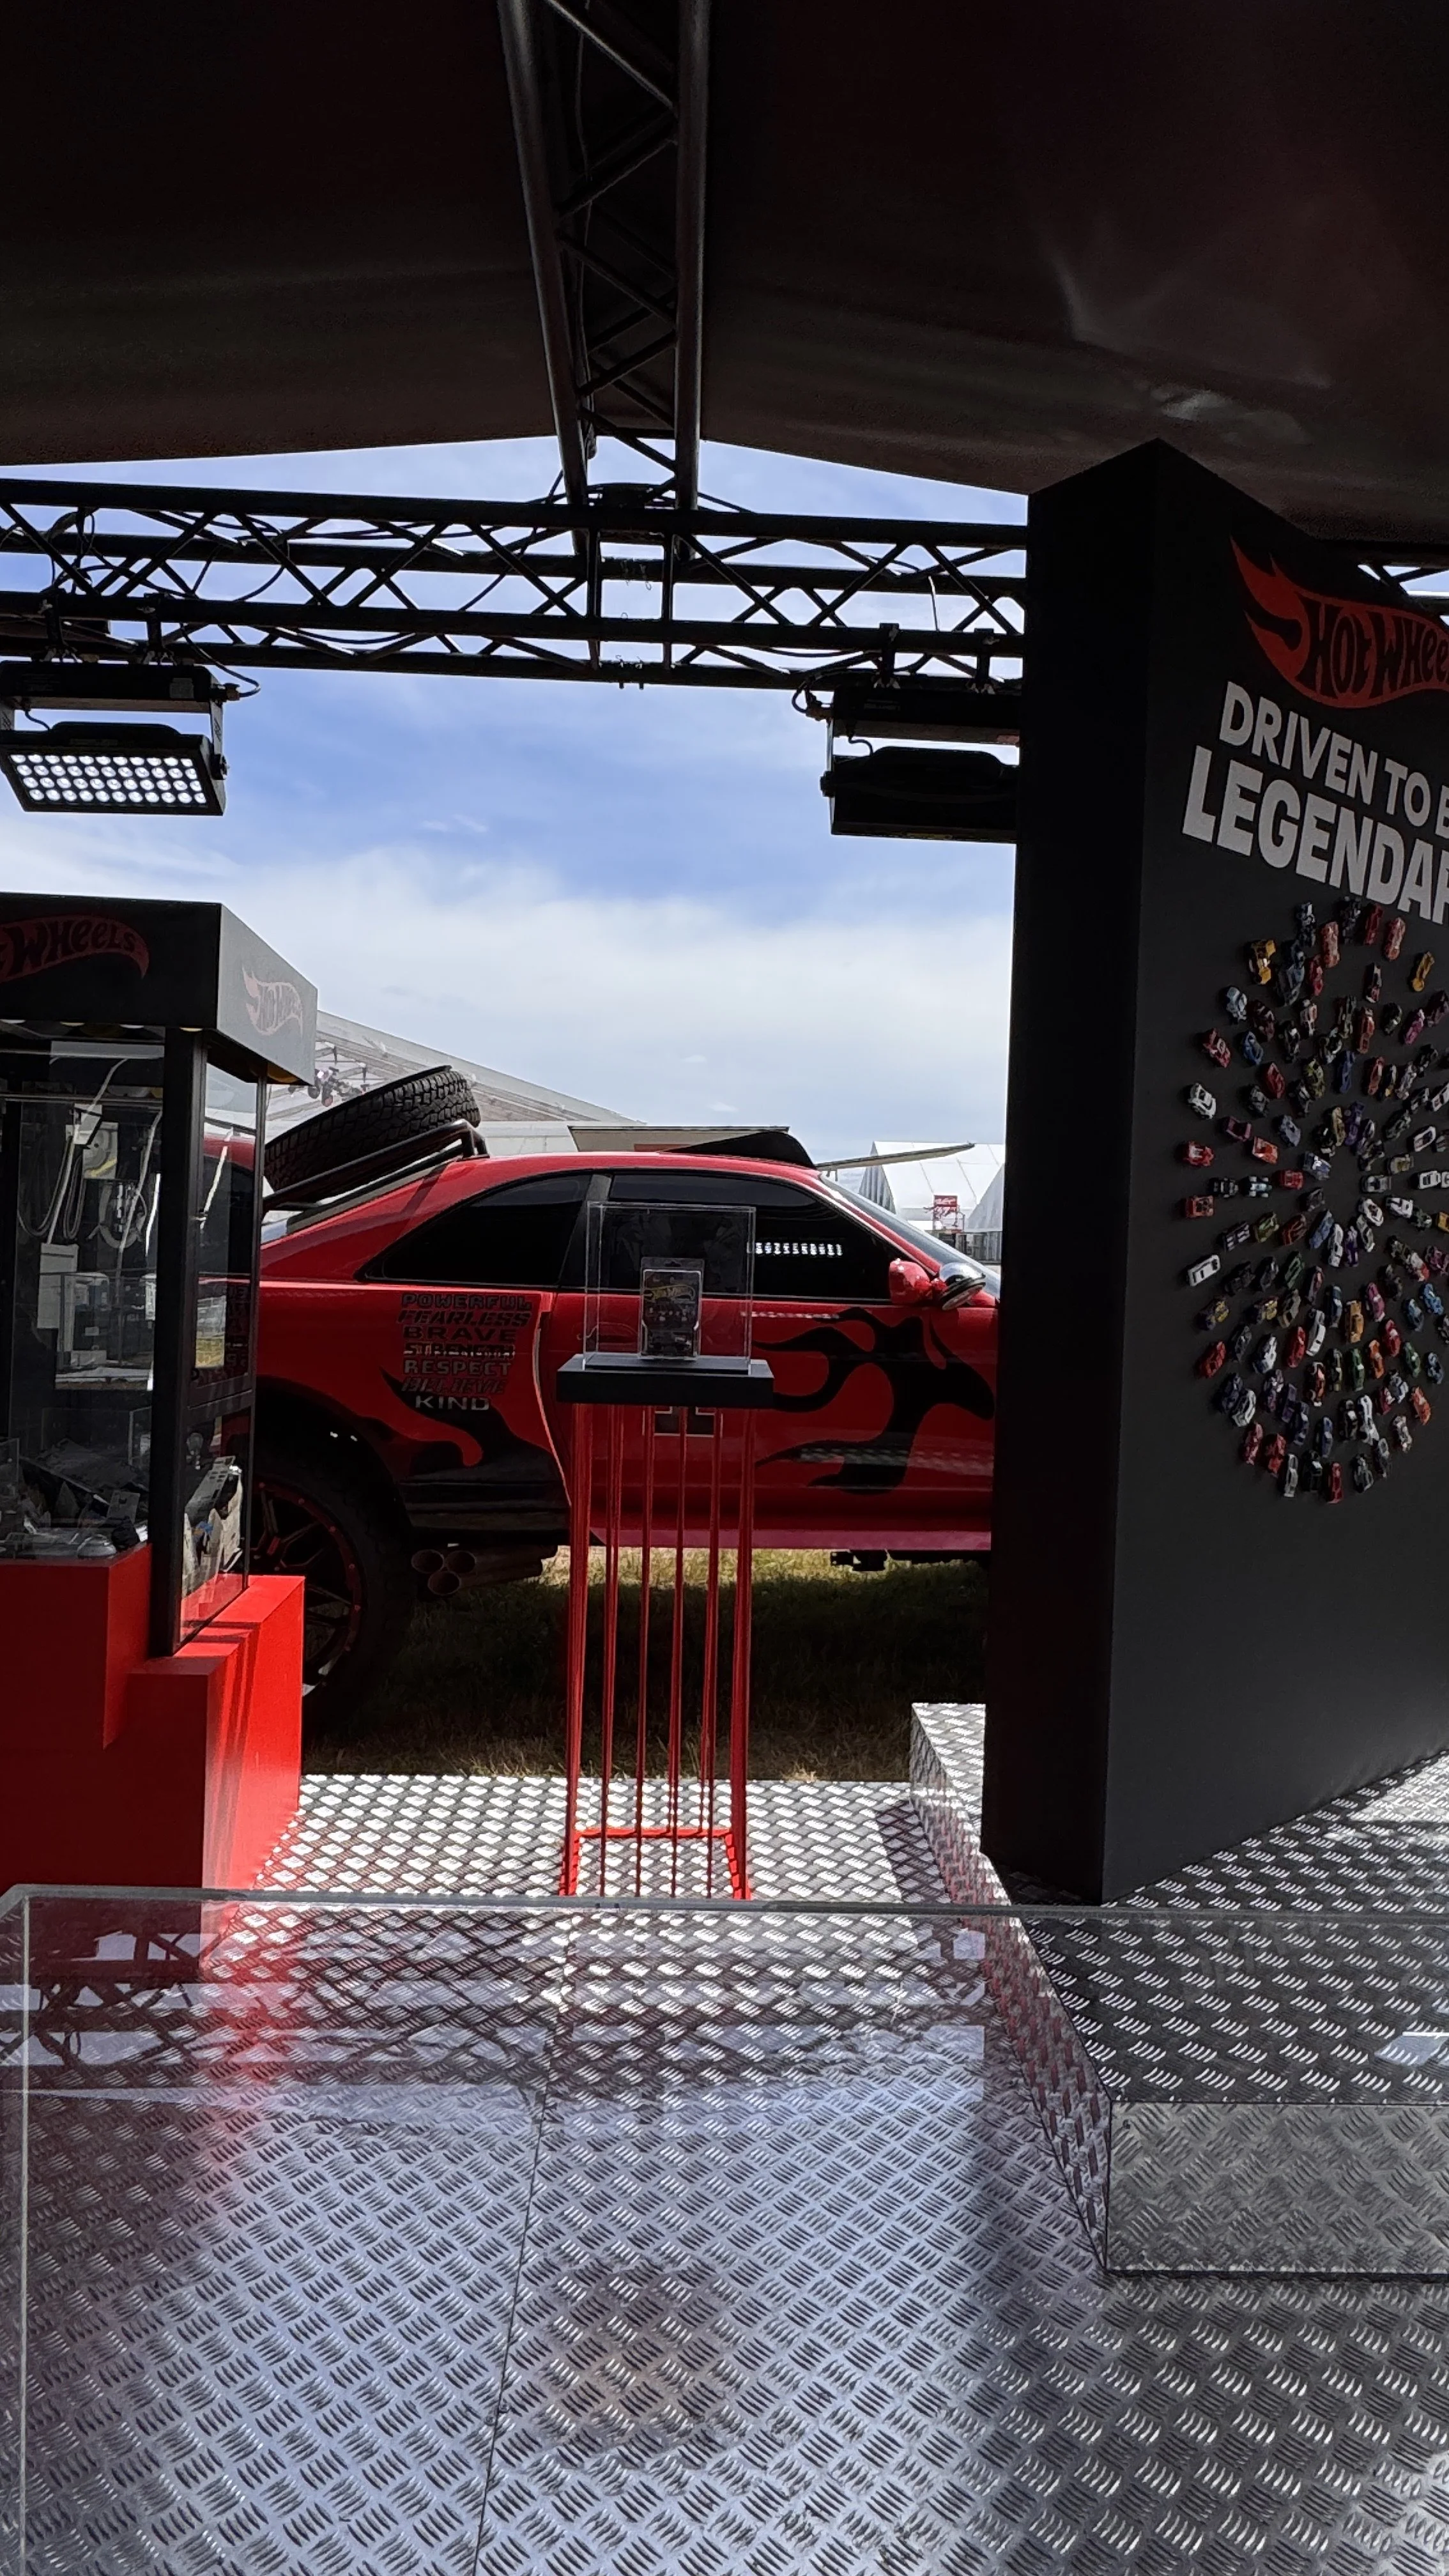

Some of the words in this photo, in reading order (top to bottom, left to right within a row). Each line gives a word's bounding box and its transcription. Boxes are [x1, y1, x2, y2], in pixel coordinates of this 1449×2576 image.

[1219, 681, 1377, 804] DRIVEN
[1384, 755, 1431, 827] TO
[401, 1292, 533, 1310] POWERFUL
[397, 1310, 533, 1327] FEARLESS
[403, 1326, 516, 1342] BRAVE
[403, 1342, 516, 1360] STRENGTH
[404, 1359, 512, 1376] RESPECT
[415, 1395, 491, 1411] KIND
